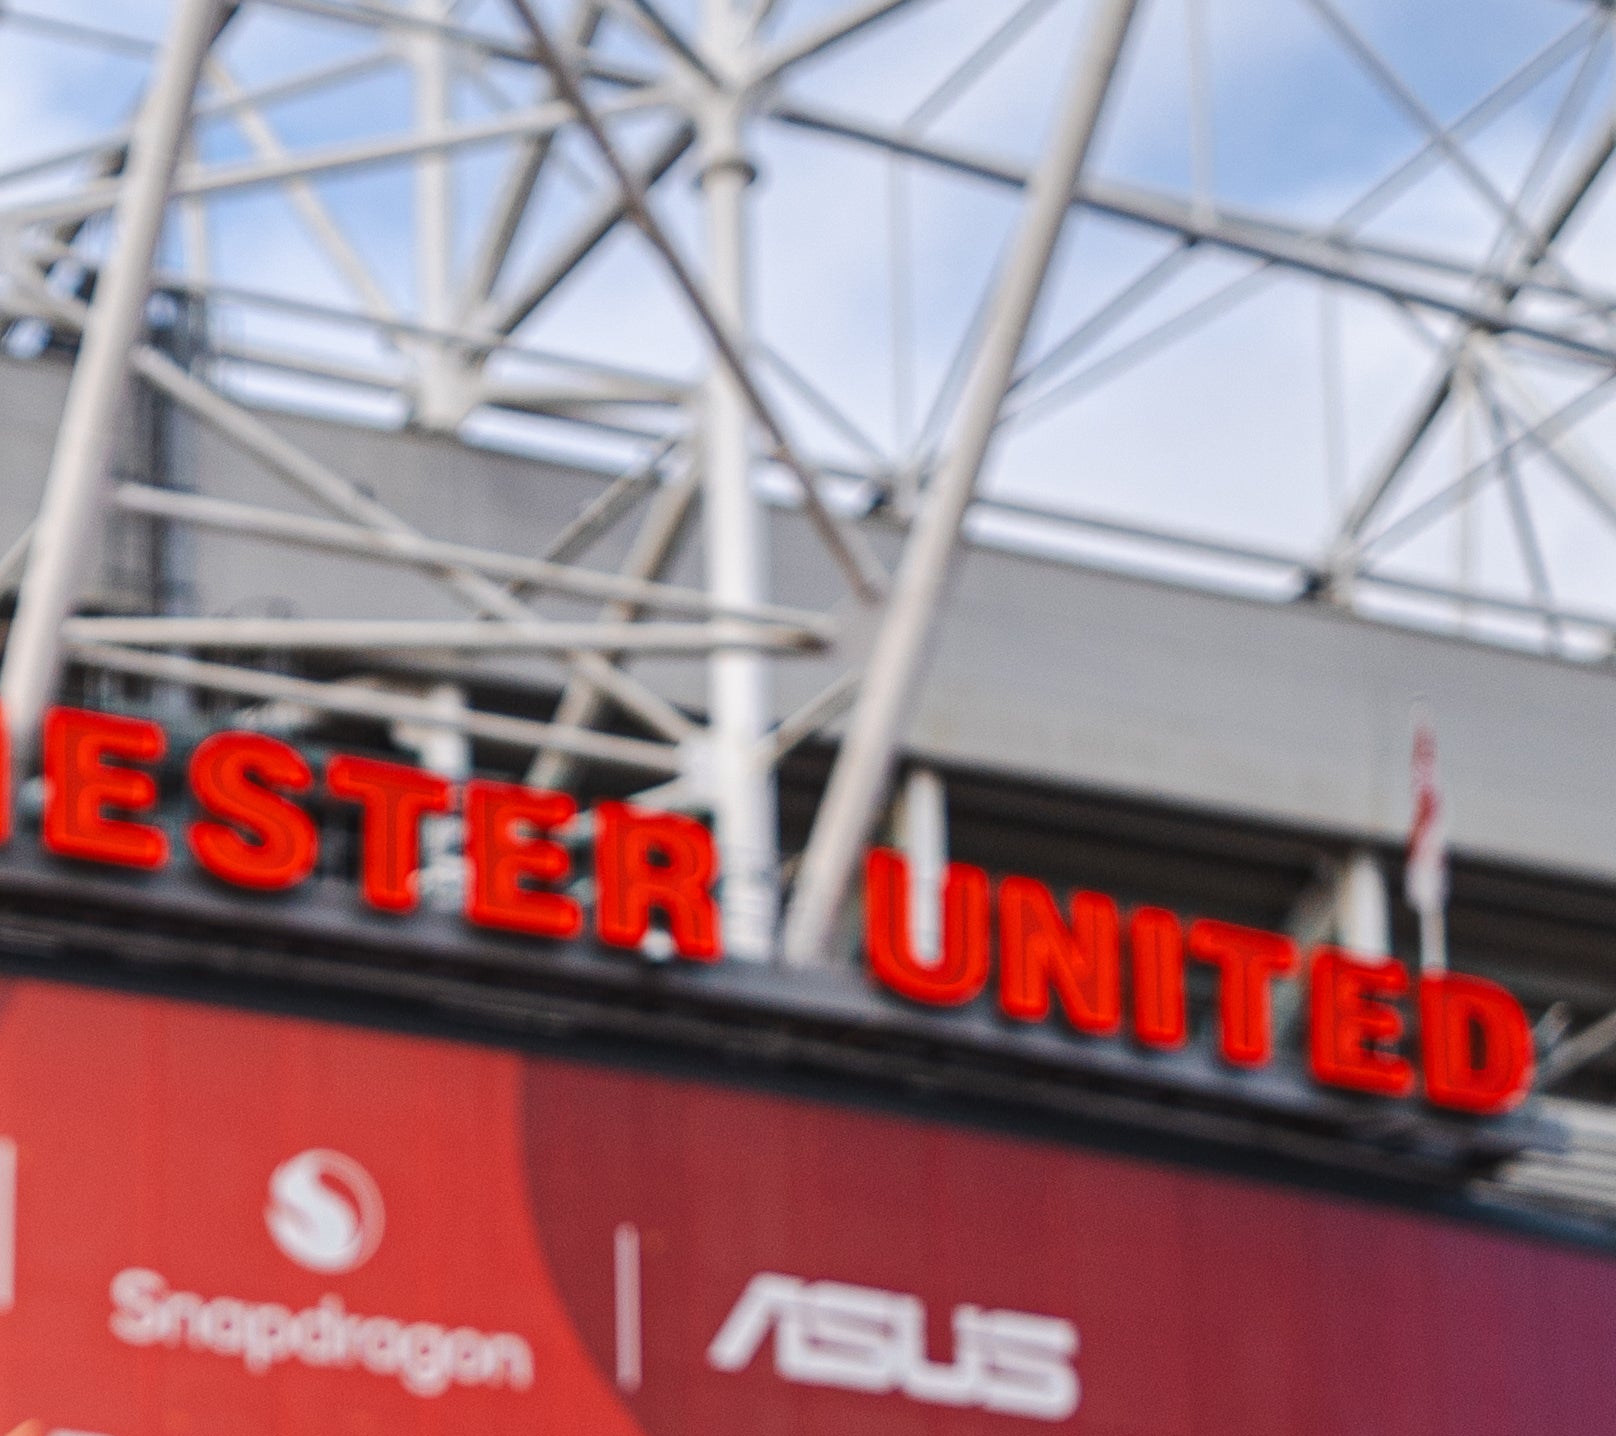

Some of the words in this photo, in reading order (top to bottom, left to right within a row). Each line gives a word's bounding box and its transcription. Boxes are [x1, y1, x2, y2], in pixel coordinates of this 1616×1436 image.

[863, 845, 1535, 1115] UNITED
[109, 1268, 534, 1396] Snapdragon
[706, 1273, 1080, 1420] ASUS
